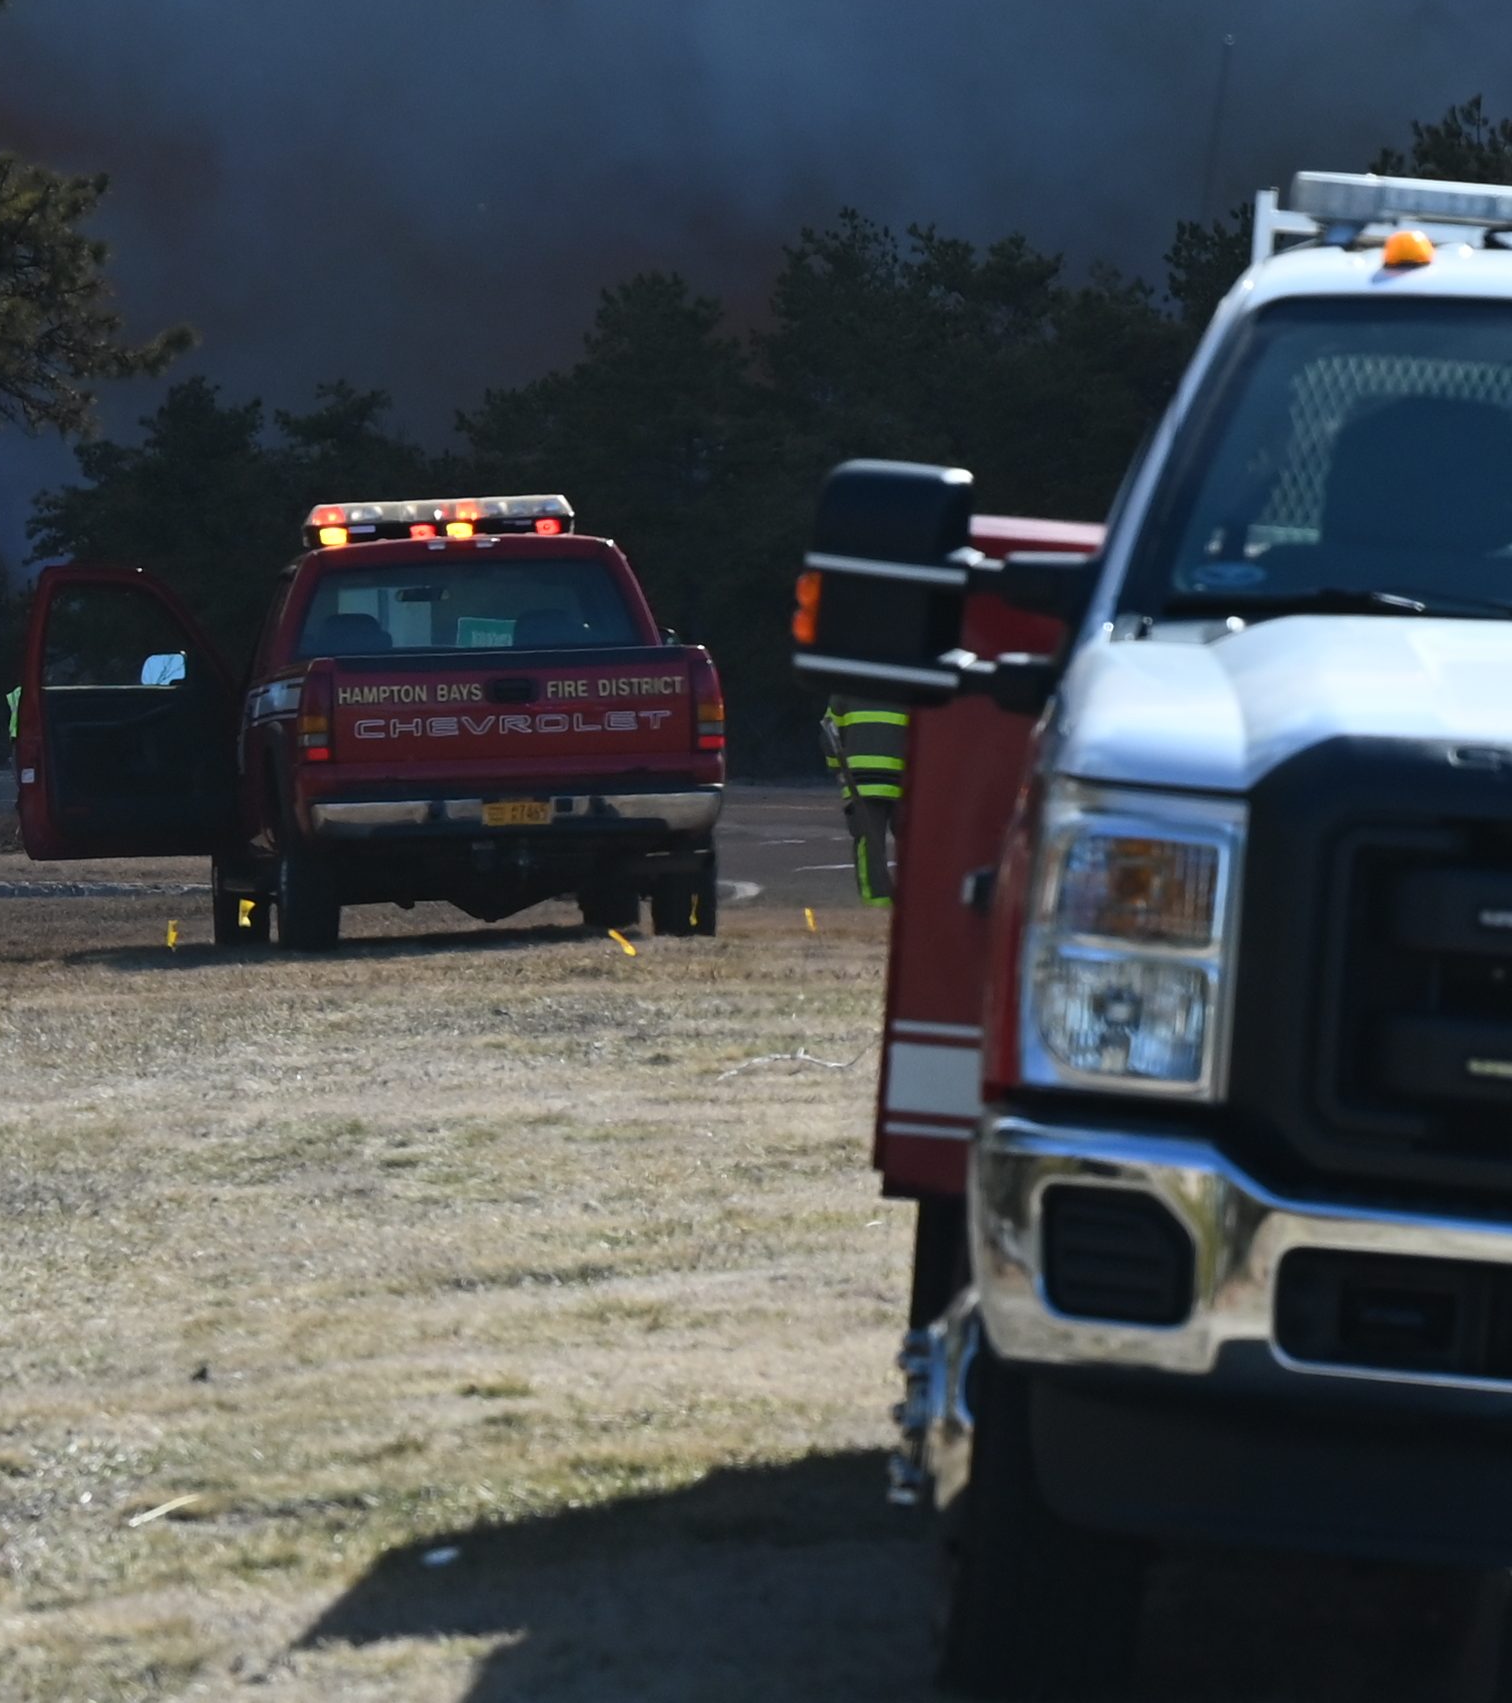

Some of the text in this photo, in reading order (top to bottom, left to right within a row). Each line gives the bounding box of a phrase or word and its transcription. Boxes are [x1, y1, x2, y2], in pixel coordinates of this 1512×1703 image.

[338, 675, 684, 705] HAMPTON BAYS FIRE DISTRICT
[354, 710, 672, 739] CHEVROLET
